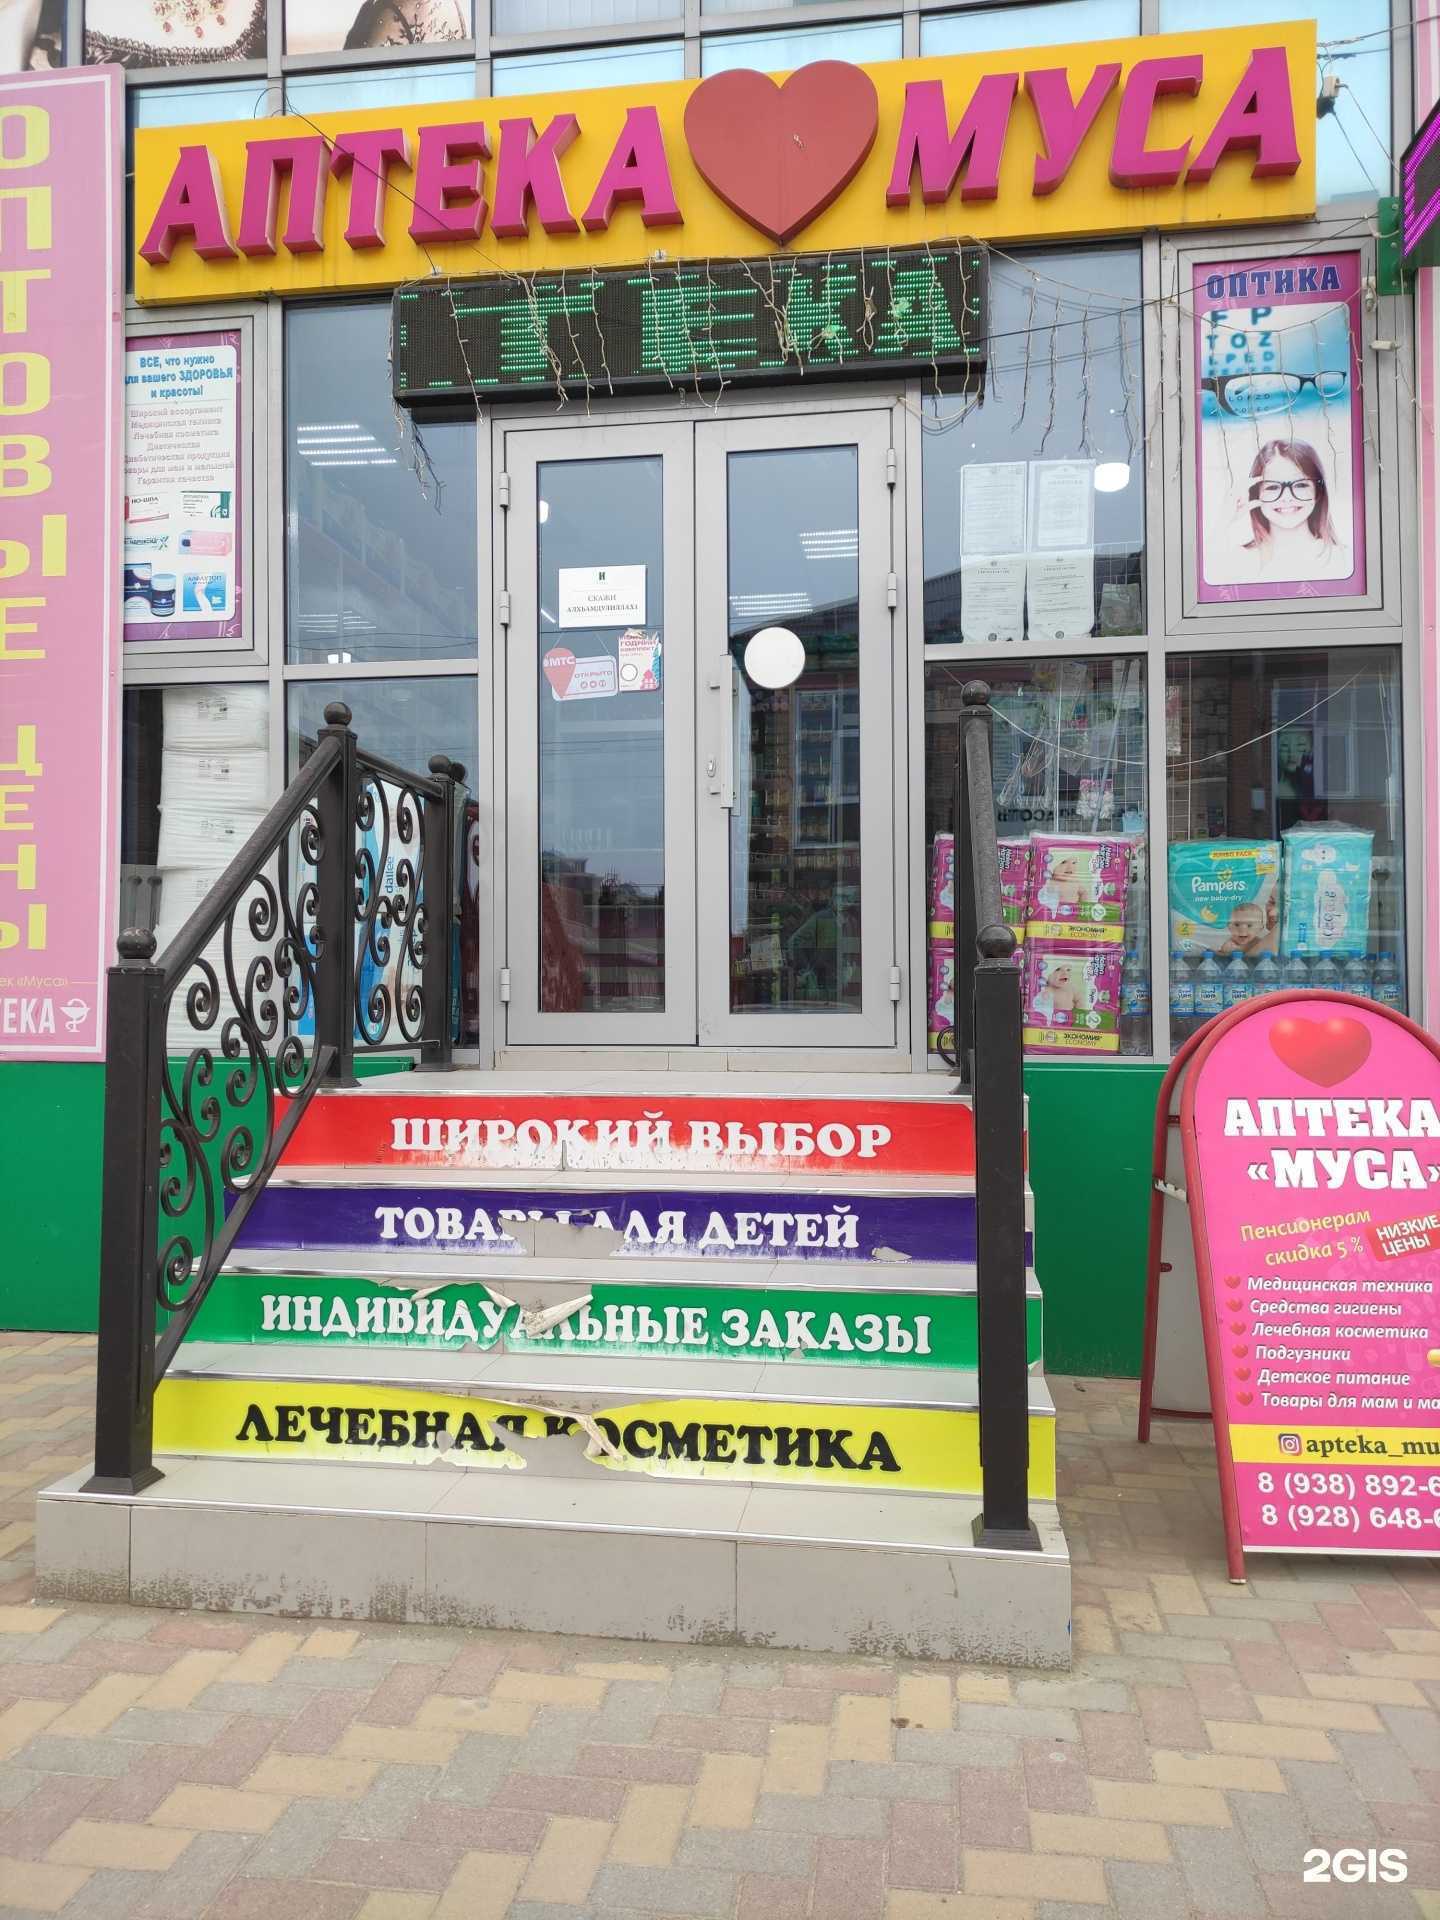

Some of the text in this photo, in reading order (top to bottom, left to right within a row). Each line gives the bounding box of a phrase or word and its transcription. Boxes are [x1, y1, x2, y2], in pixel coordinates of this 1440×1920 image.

[886, 46, 1301, 208] МУСА
[139, 106, 684, 265] АПТЕКА
[1206, 265, 1341, 299] ОПТИКА
[140, 355, 215, 368] ВСЕ, что нужно
[142, 373, 177, 384] вашего
[180, 367, 233, 382] ЗДОРОВЬЯ
[151, 384, 204, 399] и красоты!
[385, 855, 395, 894] dailee
[1191, 876, 1247, 894] Pampers
[0, 998, 56, 1034] ЕКА
[1224, 1097, 1440, 1137] АПТЕКА
[391, 1110, 893, 1158] ШИРОКИЙ ВЫБОР
[699, 1205, 860, 1250] ДЕТЕЙ
[1240, 1210, 1371, 1242] Пенсионерам
[1376, 1215, 1440, 1241] НИЗКИЕ
[1265, 1243, 1333, 1266] скидка
[1382, 1233, 1431, 1257] ЦЕНЫ
[1247, 1277, 1433, 1294] Медицинская техника
[1250, 1299, 1402, 1316] Средства гигиены
[721, 1308, 931, 1355] ЗАКАЗЫ
[1252, 1322, 1429, 1339] Лечебная косметика
[1255, 1345, 1351, 1364] Подгузники
[1257, 1368, 1410, 1386] Детское питание
[1261, 1392, 1323, 1410] Товары
[1328, 1392, 1357, 1409] для
[1361, 1396, 1399, 1409] мам
[1403, 1396, 1413, 1409] и
[1257, 1472, 1275, 1493] 8
[1284, 1472, 1356, 1499] (938)
[1261, 1503, 1279, 1526] 8
[1288, 1504, 1360, 1533] (928)
